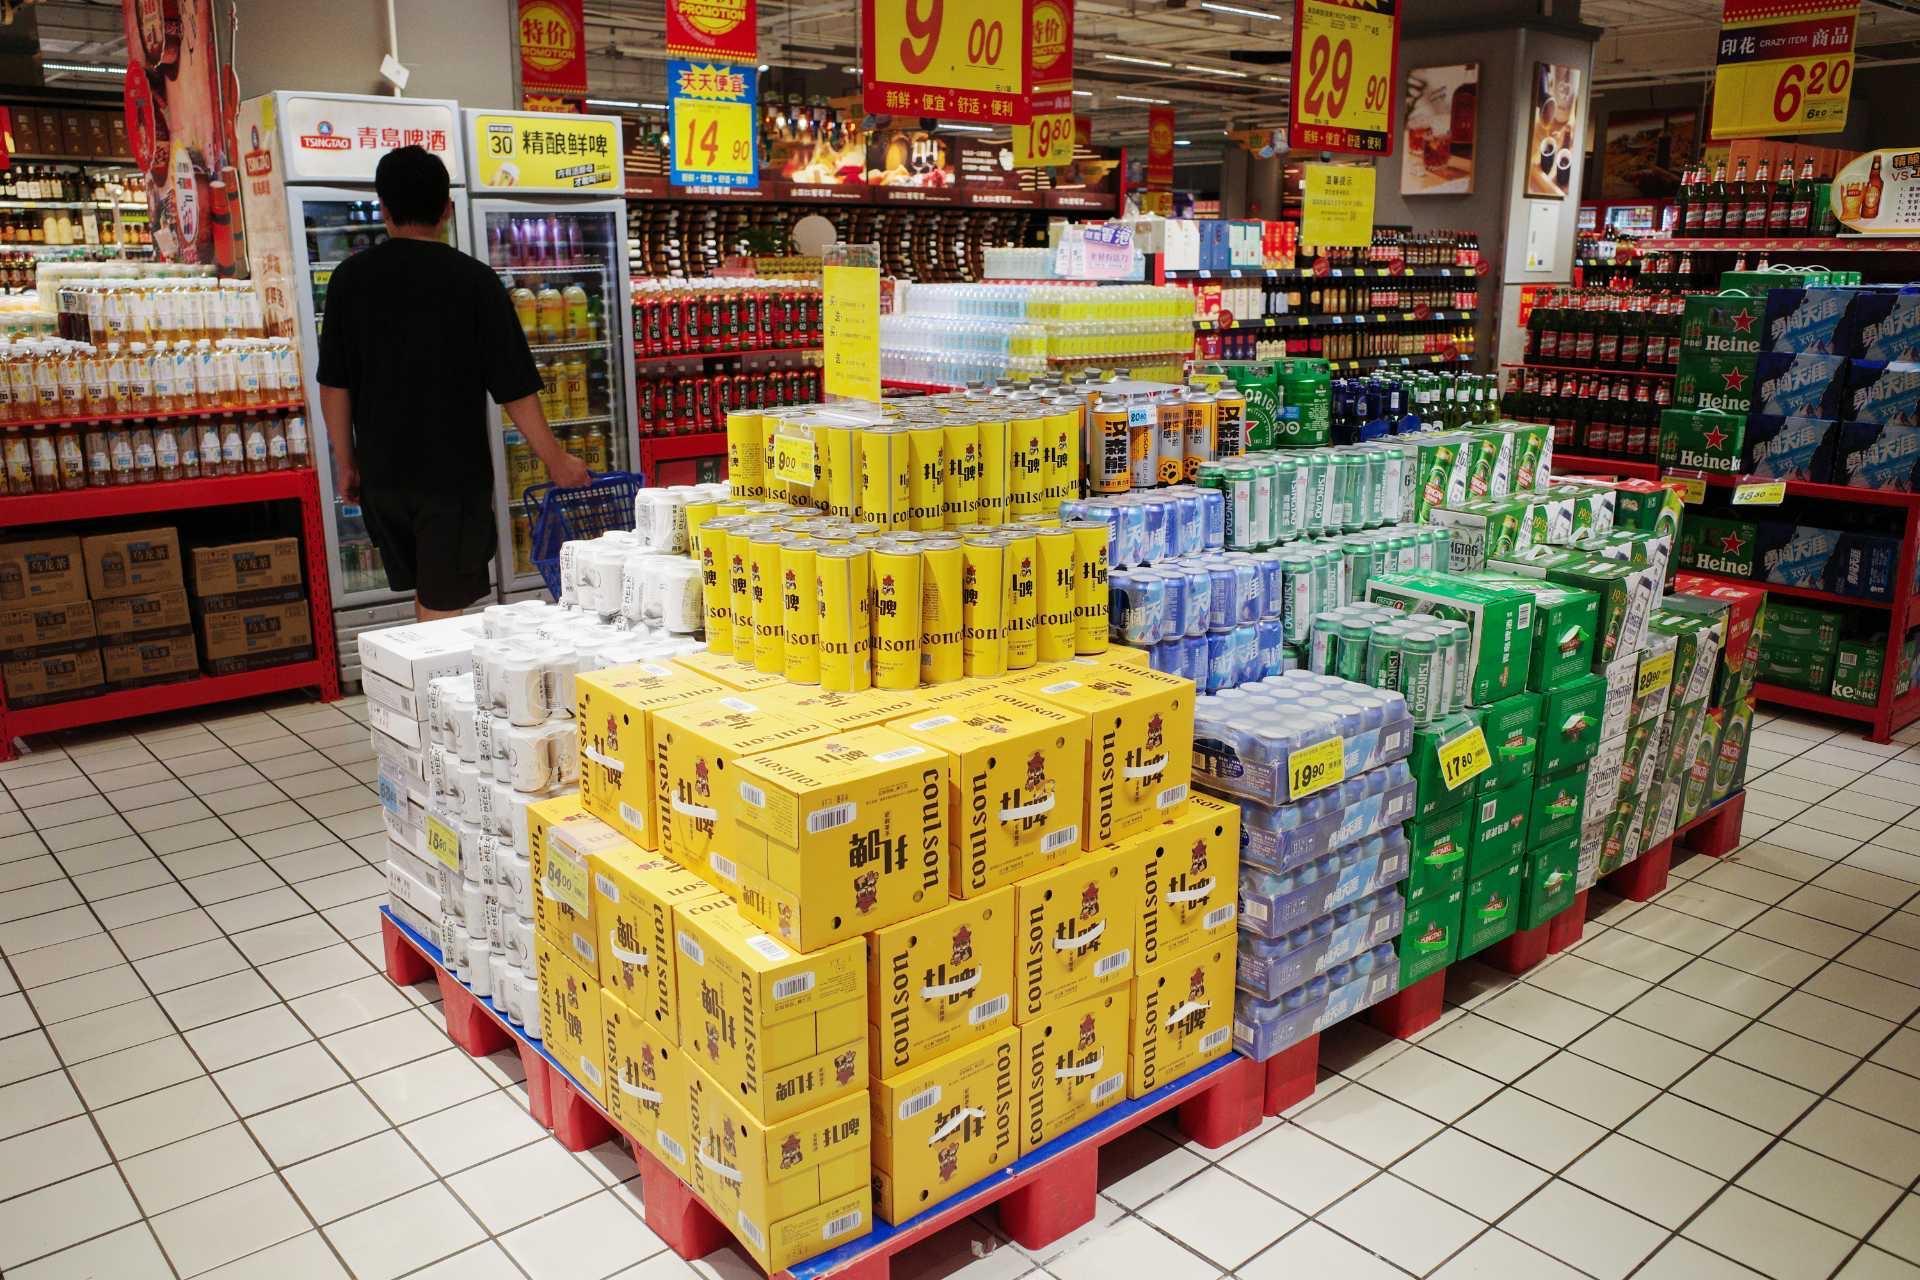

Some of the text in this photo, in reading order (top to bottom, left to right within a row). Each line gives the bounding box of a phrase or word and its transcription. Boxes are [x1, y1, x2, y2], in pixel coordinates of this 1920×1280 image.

[523, 18, 567, 47] 特价
[679, 4, 746, 21] PROMOTION
[1721, 26, 1849, 55] 印花 CRAZY ITEM 商品
[682, 73, 744, 93] 天天便宜
[302, 137, 350, 149] TSINGTAO
[491, 135, 513, 154] 30
[522, 130, 608, 158] 精酿鲜啤
[1771, 298, 1839, 341] 勇闯天涯
[1761, 361, 1828, 401] 勇闯天涯
[1753, 425, 1817, 464] 勇闯天涯
[1846, 433, 1919, 474] 勇闯天涯
[1225, 488, 1236, 537] TSINGTAO
[1315, 474, 1327, 519] TSINGTAO
[1284, 574, 1297, 630] TSINGTAO
[1110, 662, 1181, 687] coulson
[1416, 662, 1429, 712] TSINGTAO
[995, 694, 1066, 721] coulson
[657, 740, 674, 855] coulson
[1100, 730, 1116, 841] coulson
[849, 828, 909, 875] 扎啤
[923, 768, 943, 892] coulson
[971, 769, 989, 891] coulson
[1144, 859, 1159, 965] coulson
[653, 903, 671, 1018] coulson
[1026, 903, 1046, 1015] coulson
[539, 954, 555, 1050] coulson
[555, 987, 584, 1047] 扎啤
[700, 978, 737, 1049] 扎啤
[891, 950, 911, 1068] coulson
[741, 971, 758, 1095] coulson
[1143, 989, 1160, 1091] coulson
[606, 1019, 623, 1122] coulson
[776, 1070, 815, 1101] 扎啤
[1030, 1039, 1046, 1147] coulson
[996, 1043, 1014, 1151] coulson
[822, 1117, 860, 1149] 扎啤
